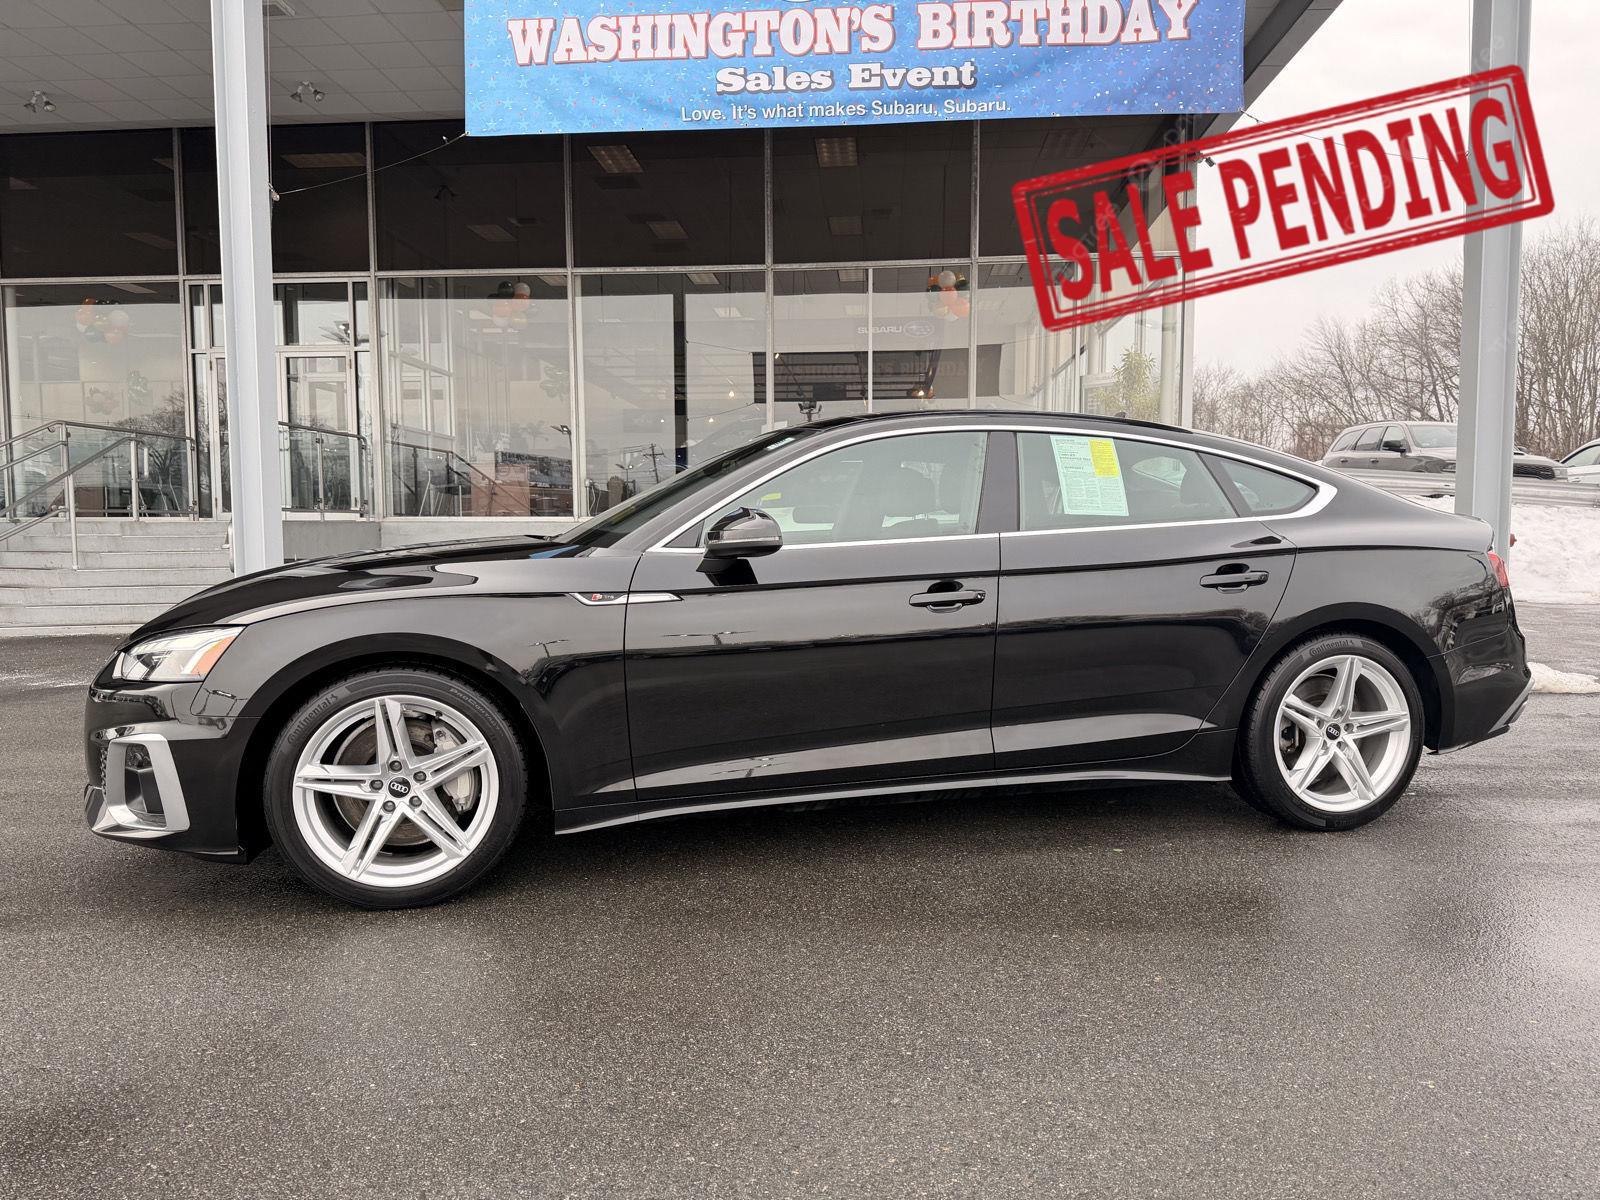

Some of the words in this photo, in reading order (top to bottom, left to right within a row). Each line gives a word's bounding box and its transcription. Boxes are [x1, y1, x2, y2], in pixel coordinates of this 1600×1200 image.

[507, 5, 896, 67] WASHINGTON'S
[916, 0, 1198, 50] BIRTHDAY
[715, 66, 835, 95] Sales
[848, 60, 978, 90] Event
[681, 106, 727, 122] Love.
[731, 104, 757, 120] It's
[763, 102, 804, 119] what
[808, 99, 866, 117] makes
[871, 97, 938, 117] Subaru,
[943, 98, 1012, 115] Subaru.
